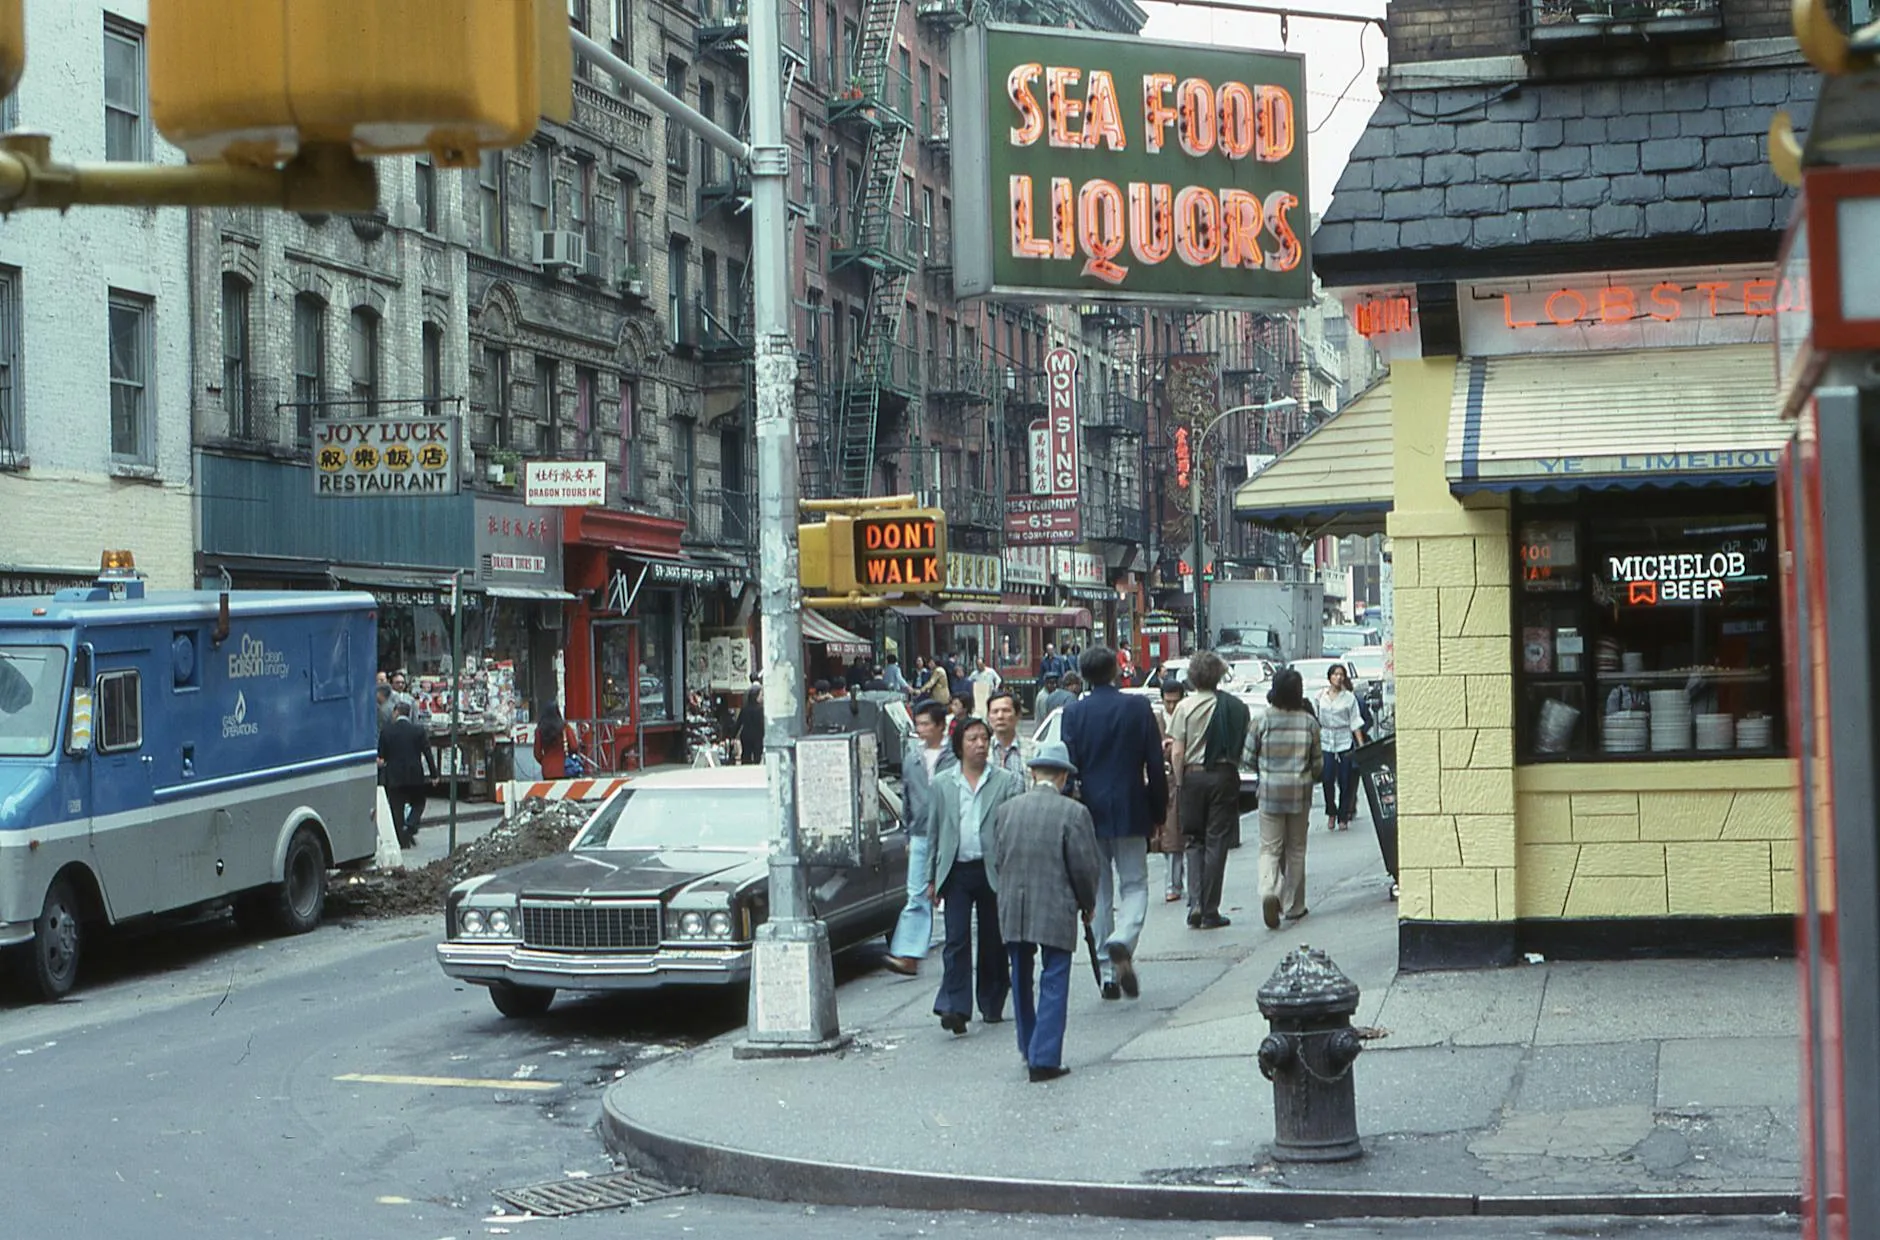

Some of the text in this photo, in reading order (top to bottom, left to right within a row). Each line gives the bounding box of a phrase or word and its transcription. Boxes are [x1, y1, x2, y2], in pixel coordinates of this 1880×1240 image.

[1007, 63, 1295, 163] SEA FOOD
[1009, 174, 1302, 285] LIQUORS
[317, 422, 448, 443] JOY LUCK
[1051, 353, 1074, 490] MON SING
[1538, 456, 1584, 473] YE
[319, 472, 448, 492] RESTAURANT
[528, 487, 602, 498] DRAGON TOURS INC
[1029, 514, 1052, 529] 65
[866, 522, 936, 549] DONT
[867, 557, 939, 585] WALK
[1609, 552, 1746, 582] MICHELOB
[1661, 579, 1725, 600] BEER
[951, 611, 1056, 625] MON SING
[241, 633, 264, 658] Con
[229, 653, 264, 679] Edison
